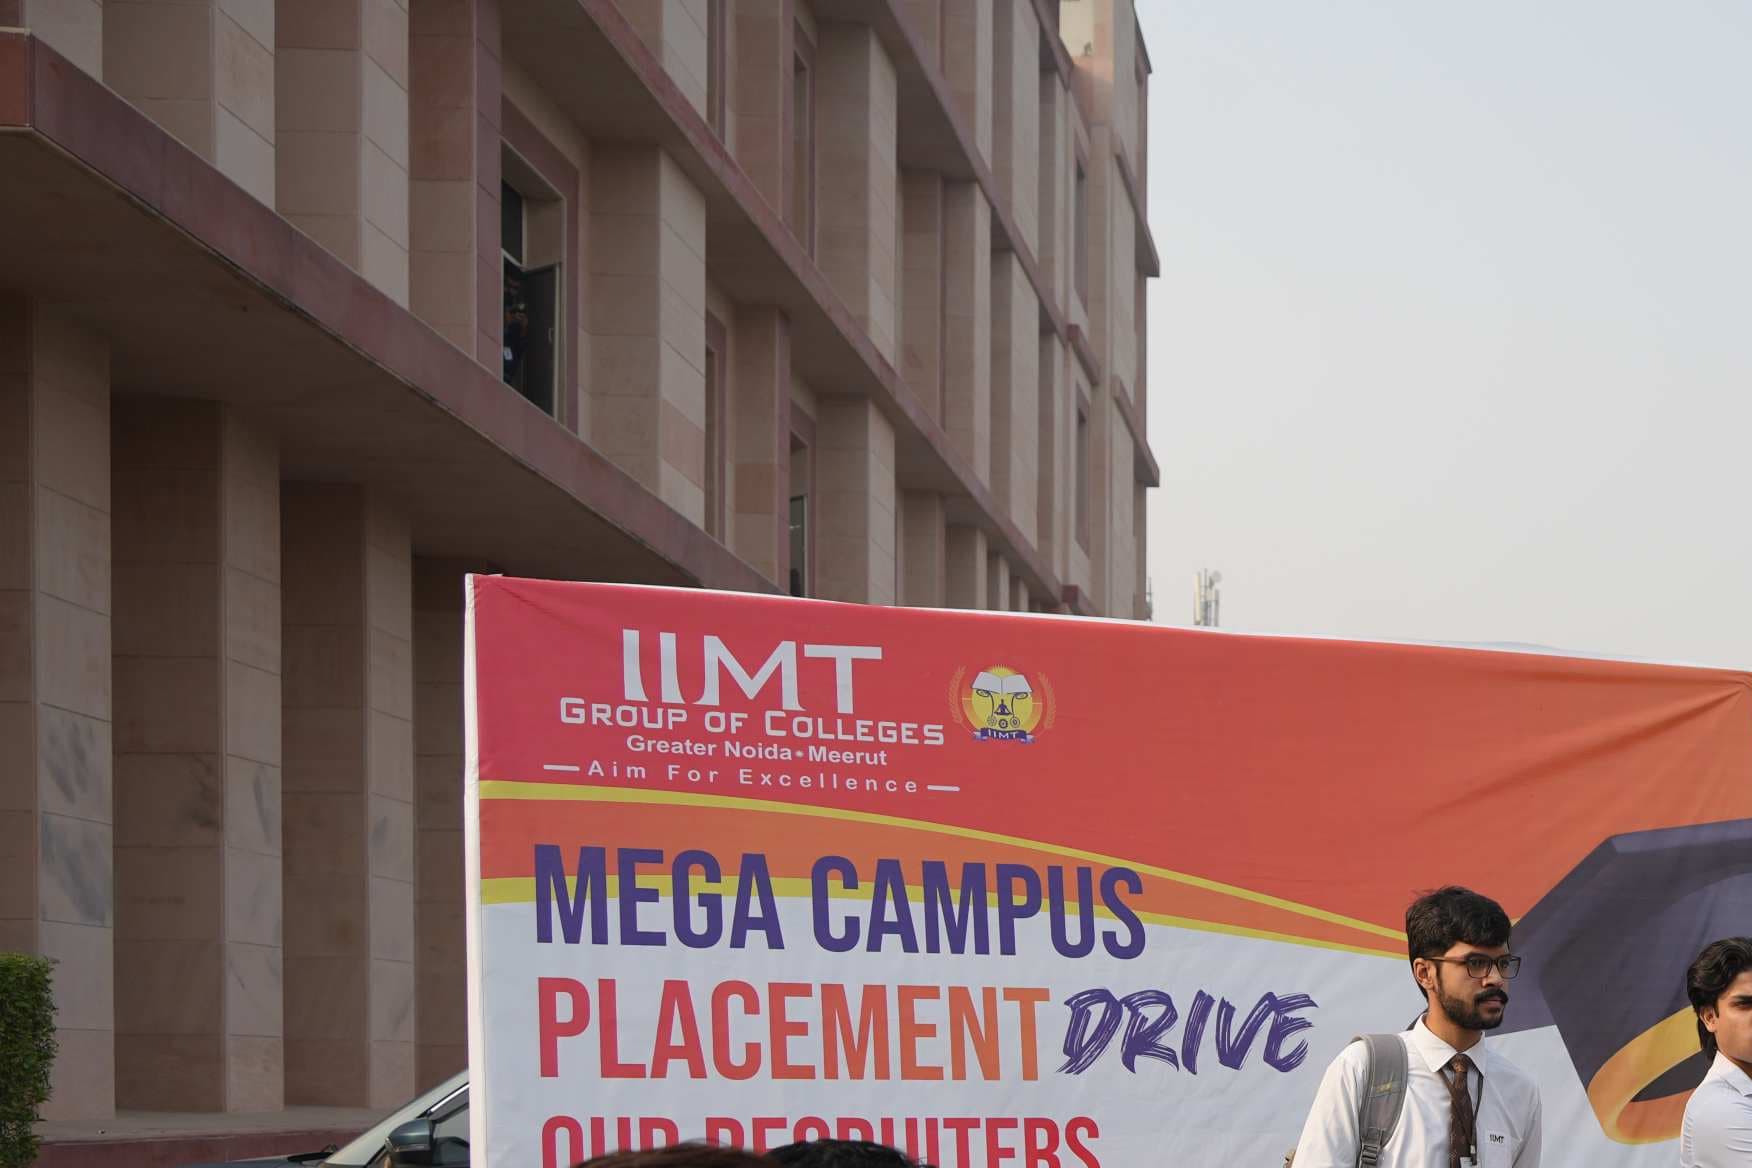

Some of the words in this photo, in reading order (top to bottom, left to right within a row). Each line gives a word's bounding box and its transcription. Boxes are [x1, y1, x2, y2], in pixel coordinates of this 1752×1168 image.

[622, 628, 882, 714] IIMT
[560, 697, 688, 731] GROUP
[704, 711, 749, 735] OF
[765, 708, 944, 746] COLLEGES
[988, 728, 1017, 739] IIMT
[626, 734, 717, 757] Greater
[808, 744, 887, 766] Meerut
[587, 761, 646, 780] Aim
[668, 764, 719, 783] For
[738, 768, 918, 793] Excellence
[534, 844, 785, 951] MEGA
[811, 855, 1146, 960] CAMPUS
[537, 976, 1050, 1081] PLACEMENT
[1058, 988, 1318, 1075] DRIVE
